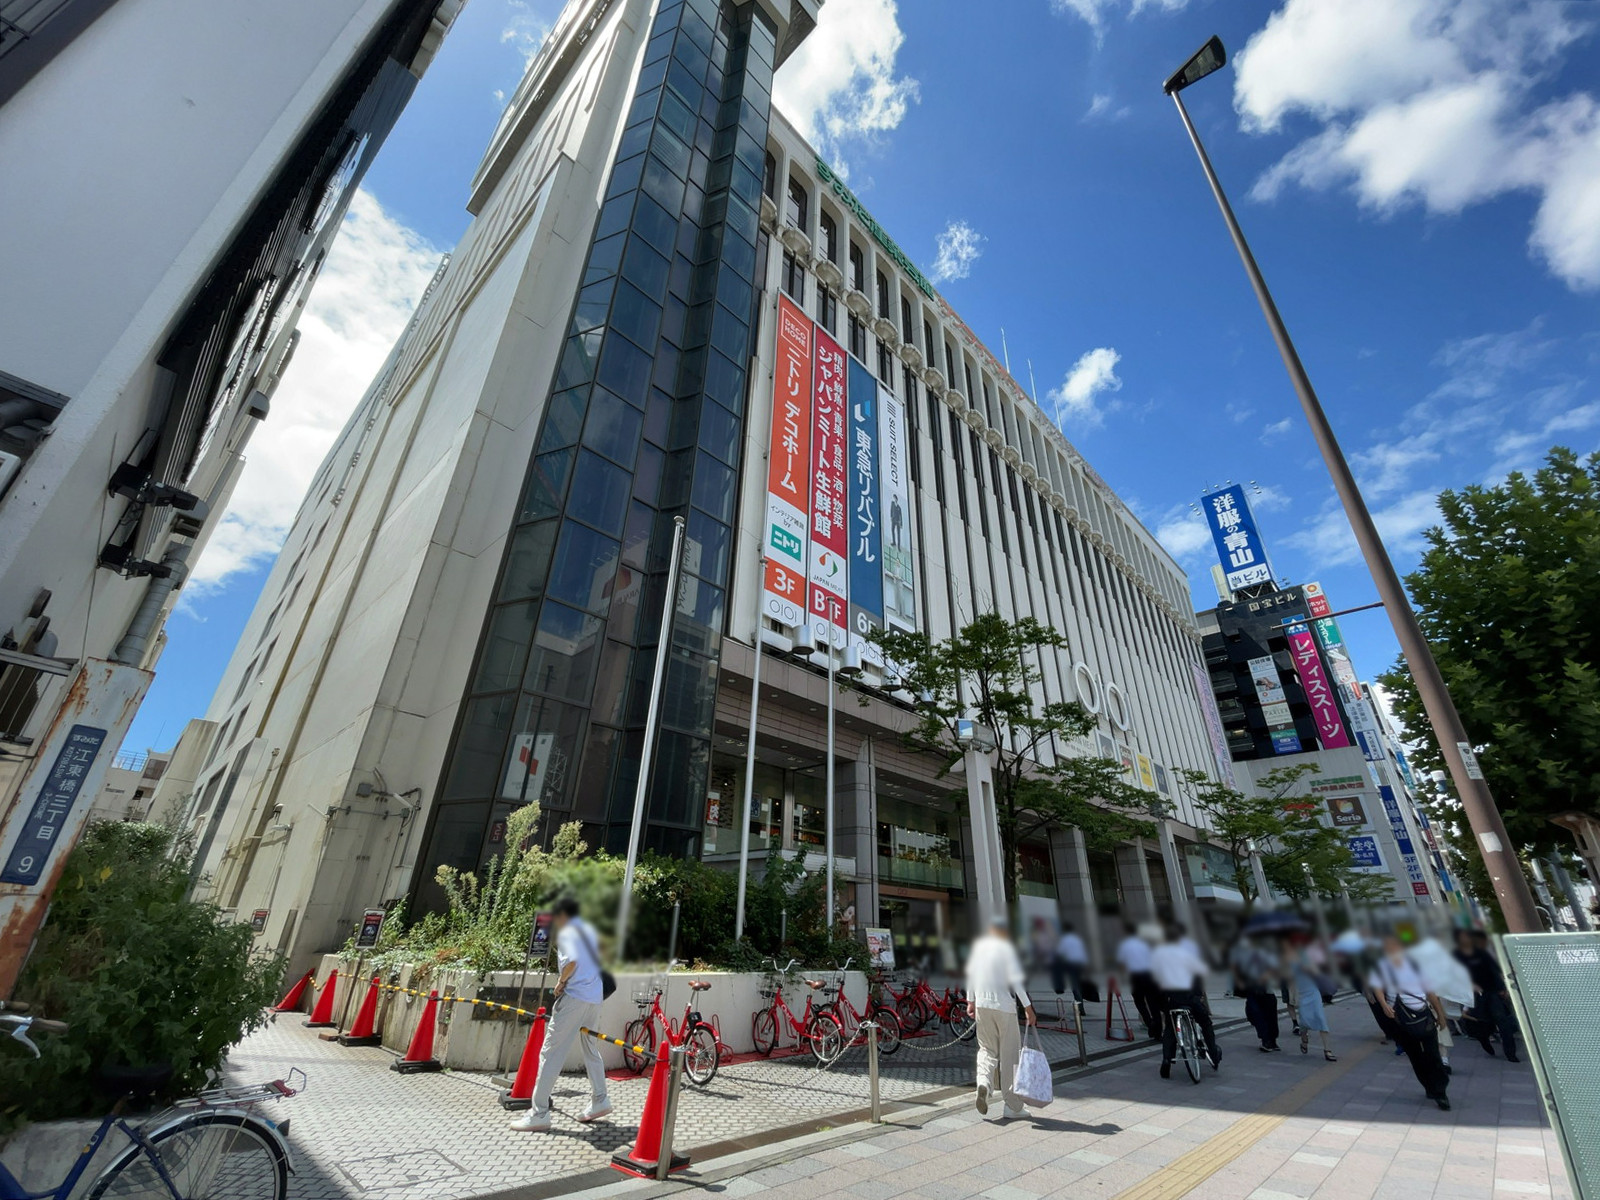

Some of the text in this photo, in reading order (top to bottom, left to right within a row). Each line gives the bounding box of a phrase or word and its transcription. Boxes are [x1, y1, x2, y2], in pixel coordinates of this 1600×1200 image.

[784, 325, 807, 348] HOME
[785, 318, 807, 340] DECO
[780, 347, 802, 495] ニトリ デコホーム
[814, 345, 833, 539] ジャパンミート生鮮館
[888, 416, 899, 488] SUIT SELECT
[856, 426, 875, 563] 東急リバブル
[1212, 492, 1255, 568] 洋服の青山
[773, 531, 800, 554] ニトリ
[773, 567, 796, 595] 3F
[1230, 568, 1268, 587] 当ビル
[814, 589, 842, 620] BF
[1248, 592, 1297, 612] 国宝ビル
[1294, 638, 1341, 739] レディススーツ
[72, 733, 100, 745] すみだ
[36, 748, 92, 841] 江東橋三丁目
[1336, 813, 1362, 823] Seria
[17, 855, 35, 874] 9
[1404, 856, 1416, 864] 3F
[1407, 864, 1419, 872] 2F
[1410, 873, 1422, 881] 1F
